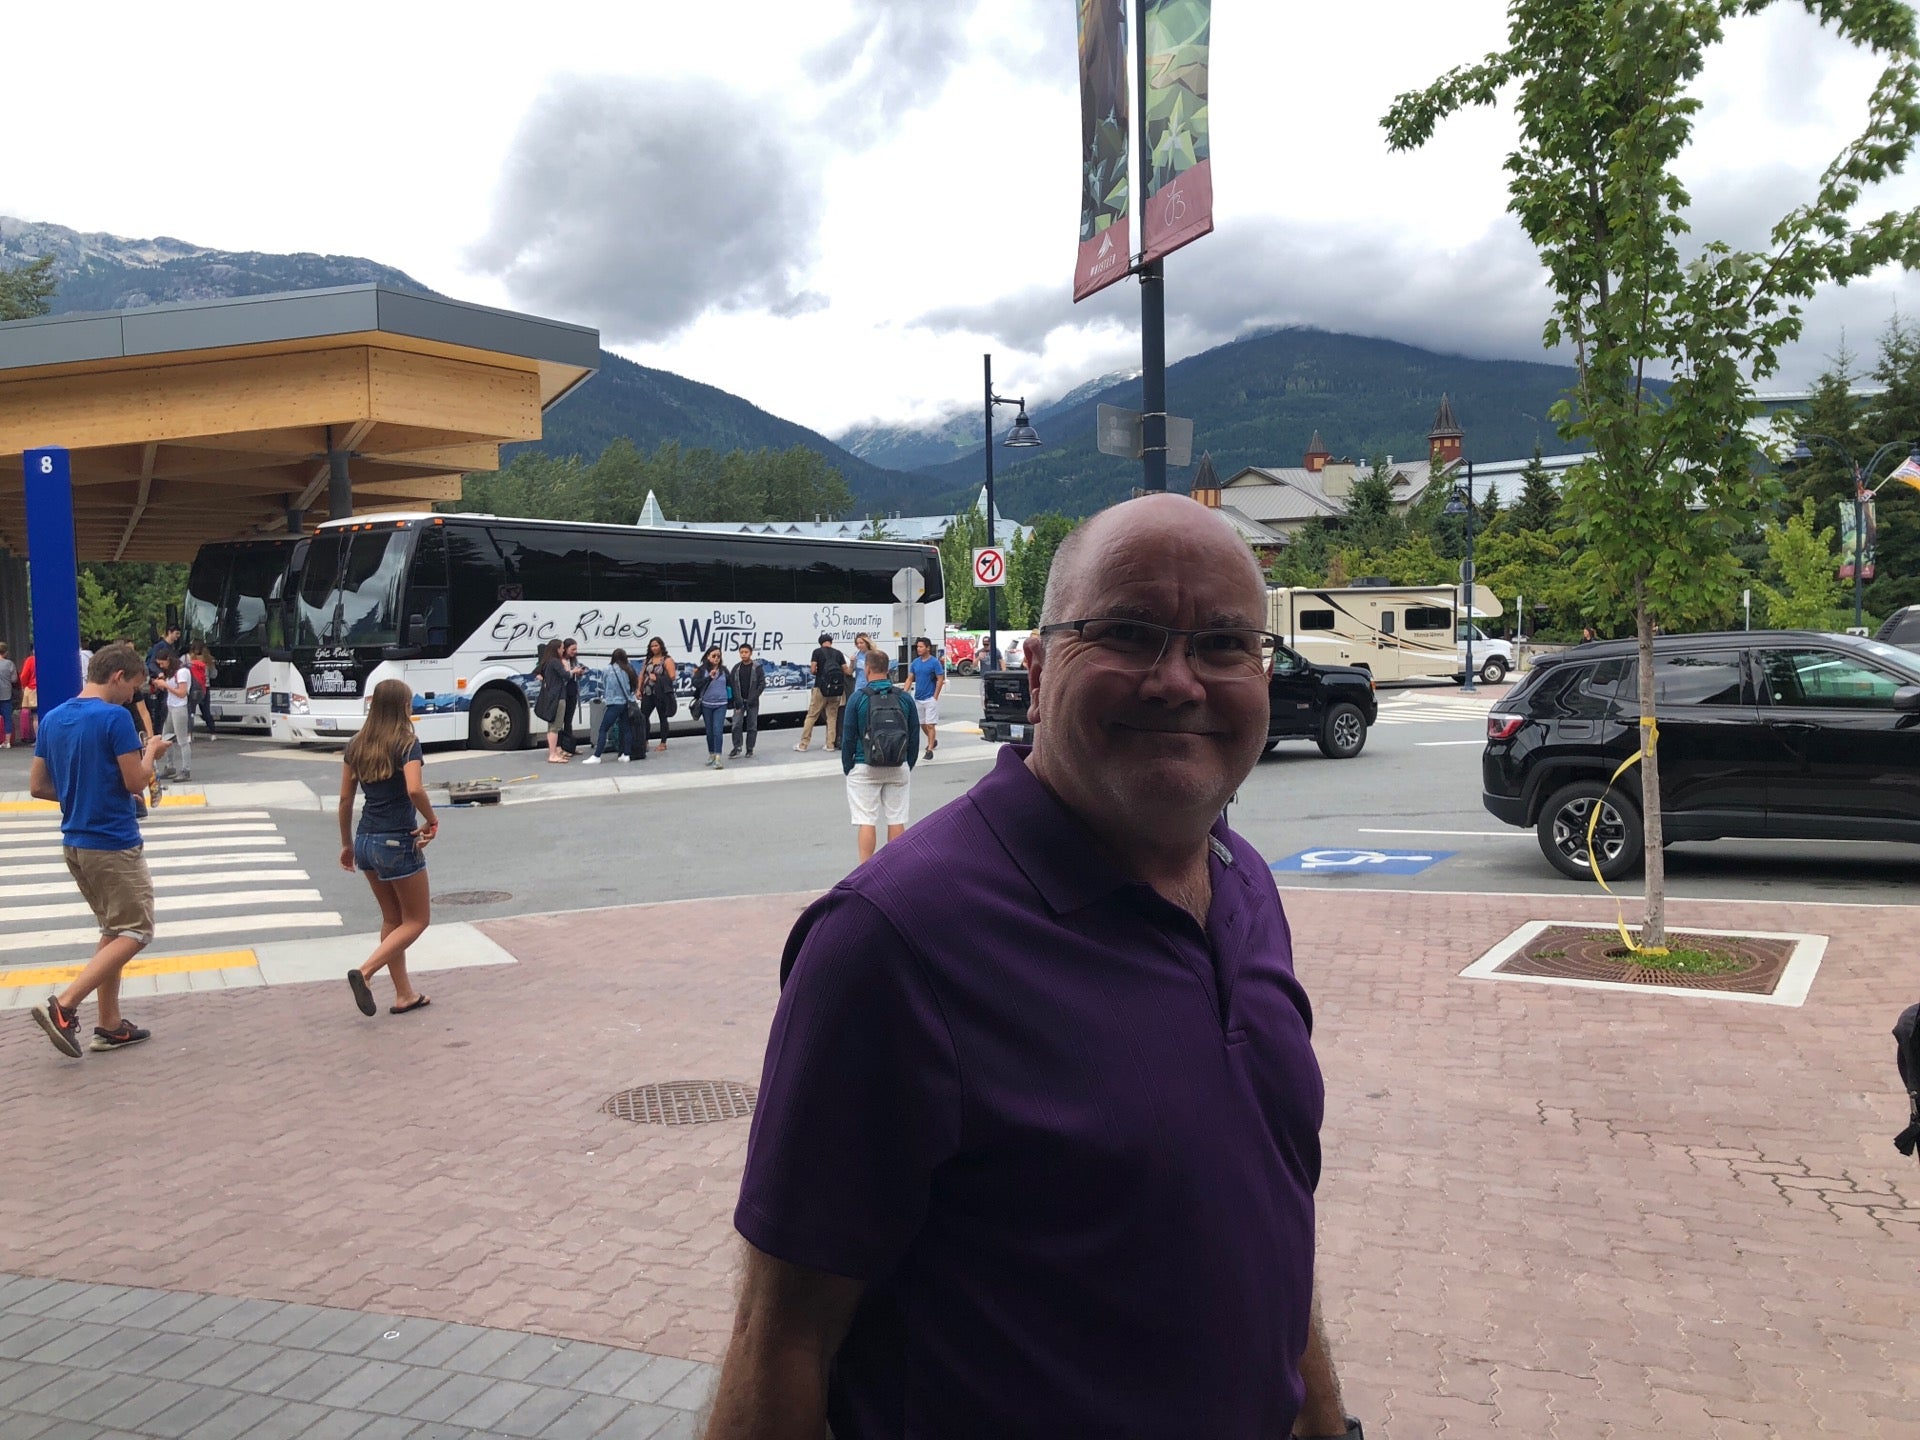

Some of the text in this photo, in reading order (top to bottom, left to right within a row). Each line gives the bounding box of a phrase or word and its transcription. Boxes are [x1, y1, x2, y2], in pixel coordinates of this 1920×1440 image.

[41, 455, 53, 474] 8
[713, 610, 753, 625] Bus To
[843, 614, 867, 626] Round
[868, 614, 882, 628] Trip
[491, 609, 651, 651] Epic Rides
[679, 618, 784, 653] WHISTLER
